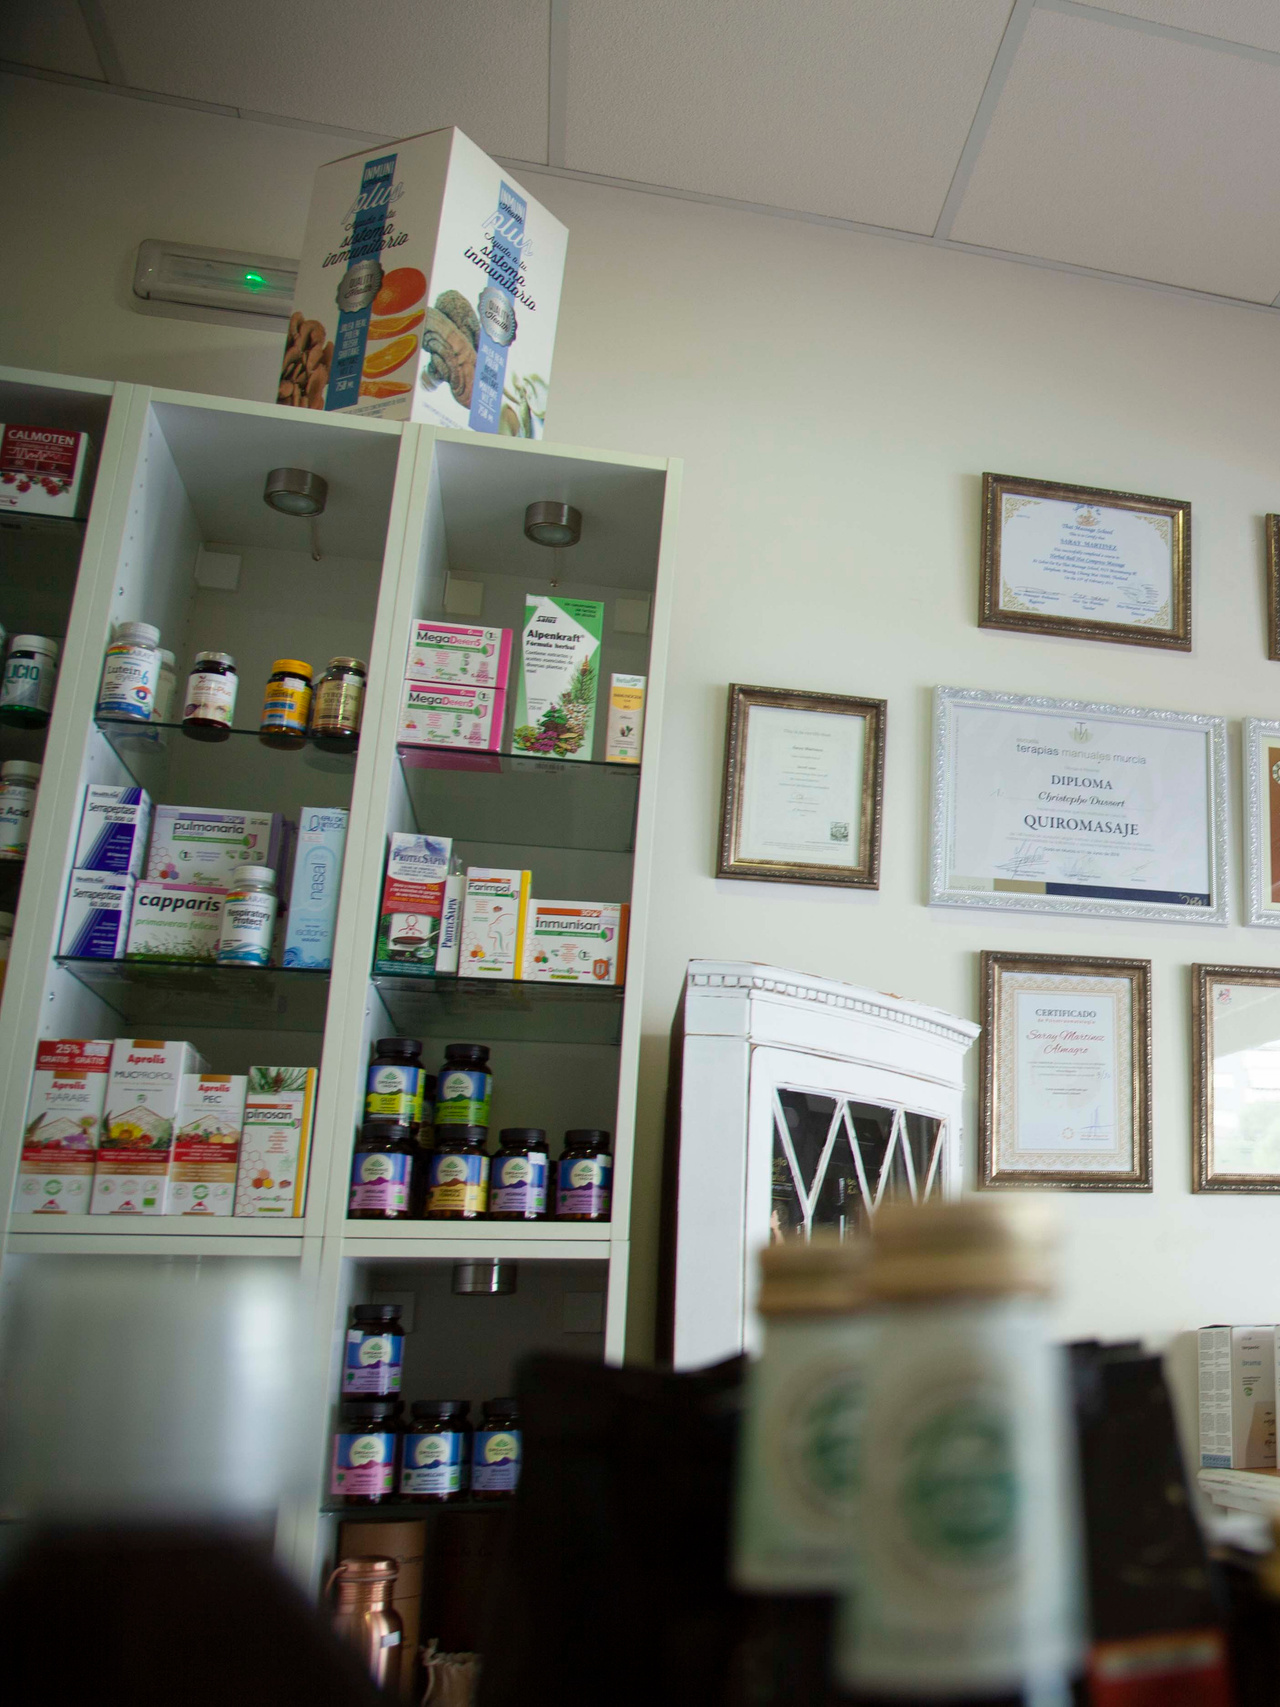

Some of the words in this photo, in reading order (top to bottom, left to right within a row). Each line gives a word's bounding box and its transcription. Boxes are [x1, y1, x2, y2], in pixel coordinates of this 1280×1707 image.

[339, 223, 395, 248] sistema
[322, 232, 409, 268] inmunitario
[480, 246, 526, 287] sistema
[464, 246, 536, 311] inmunitario
[8, 429, 75, 446] CALMOTEN
[106, 665, 141, 677] Lutein
[1016, 743, 1059, 757] terapias
[1061, 748, 1111, 761] manuales
[1112, 753, 1147, 765] murcia
[1051, 774, 1113, 791] DIPLOMA
[88, 802, 137, 816] Serrapeptasa
[173, 821, 245, 835] pulmonaria
[1024, 814, 1140, 838] QUIROMASAJE
[310, 862, 327, 901] nasal
[72, 888, 122, 901] Serrapeptasa
[138, 894, 221, 913] capparis
[227, 908, 272, 922] Respiratory
[134, 917, 189, 929] primaveras
[535, 916, 601, 931] inmunisan
[1035, 1008, 1097, 1018] CERTIFICADO
[55, 1043, 80, 1055] 25%
[126, 1053, 167, 1066] Aprolis
[51, 1080, 87, 1091] Aprolis
[197, 1082, 231, 1093] Aprolis
[202, 1095, 222, 1104] PEC
[246, 1109, 293, 1121] pinosan
